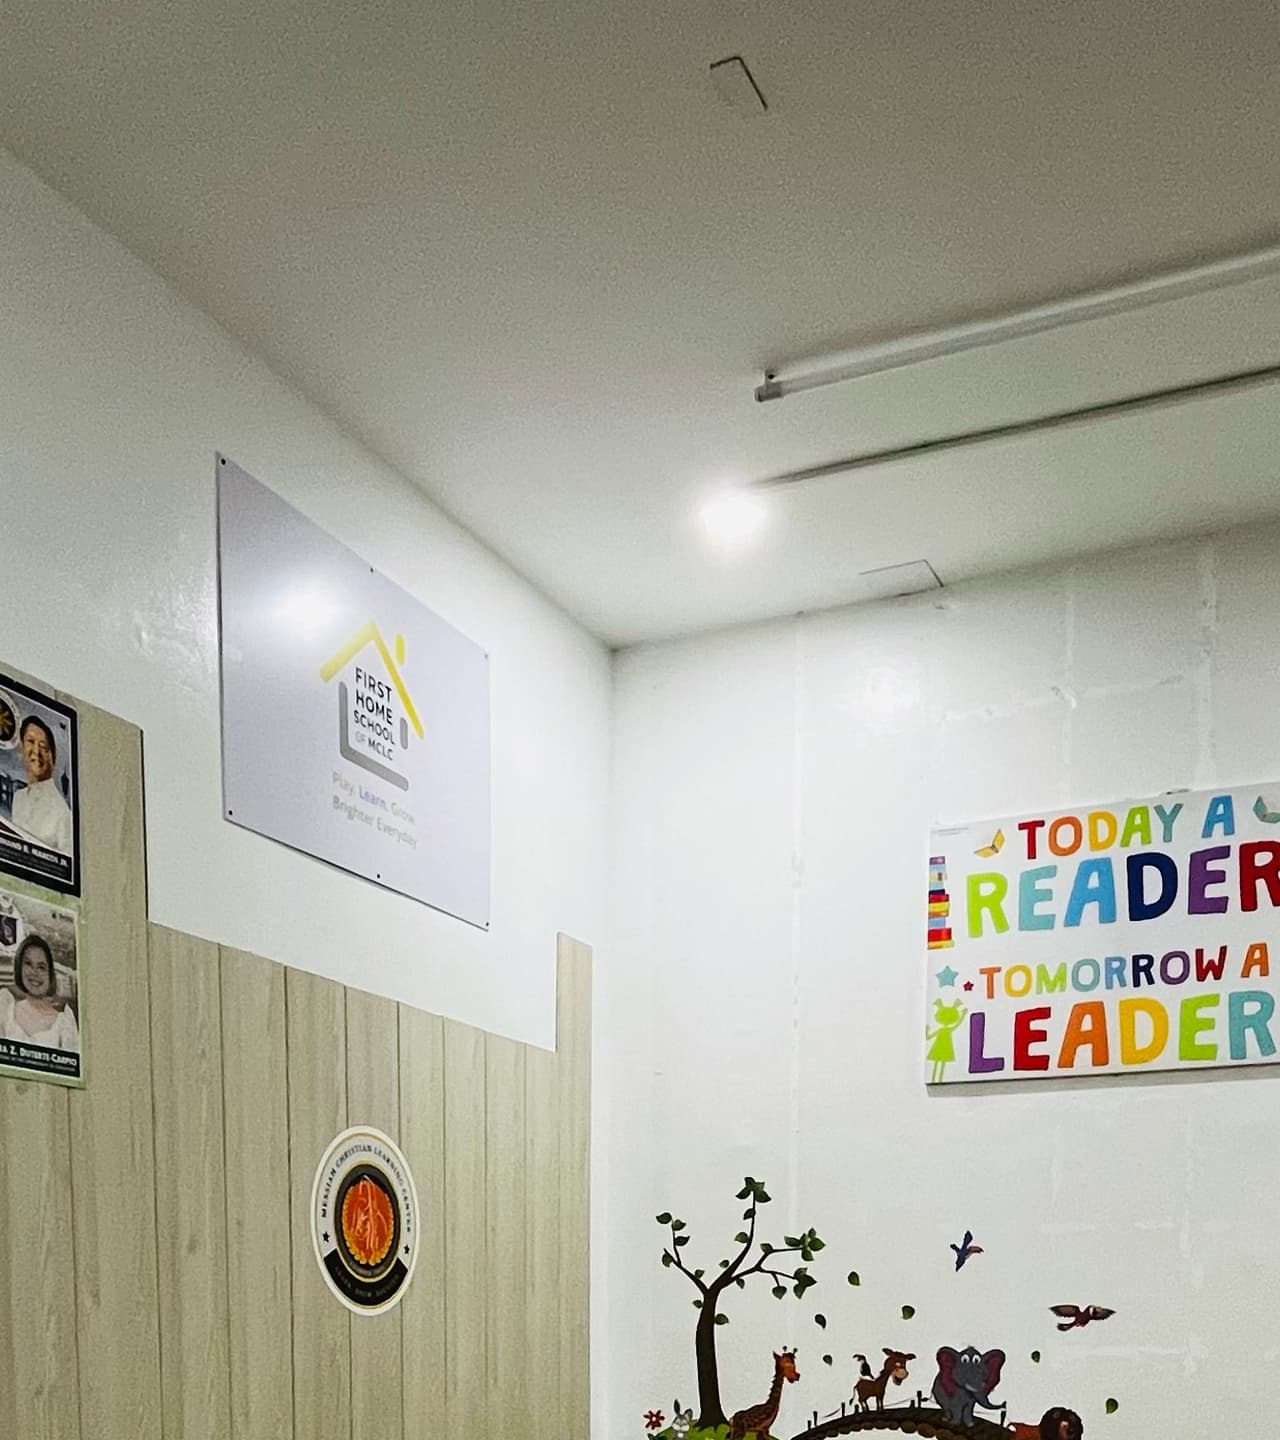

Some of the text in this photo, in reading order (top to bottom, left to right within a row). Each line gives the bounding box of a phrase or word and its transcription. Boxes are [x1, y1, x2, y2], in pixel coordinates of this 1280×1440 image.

[355, 667, 392, 703] FIRST
[356, 689, 392, 726] HOME
[353, 709, 395, 745] SCHOOL
[368, 737, 393, 761] MCLC
[1018, 795, 1235, 860] TODAY A
[979, 942, 1270, 999] TOMORROW A
[968, 991, 1276, 1074] LEADER
